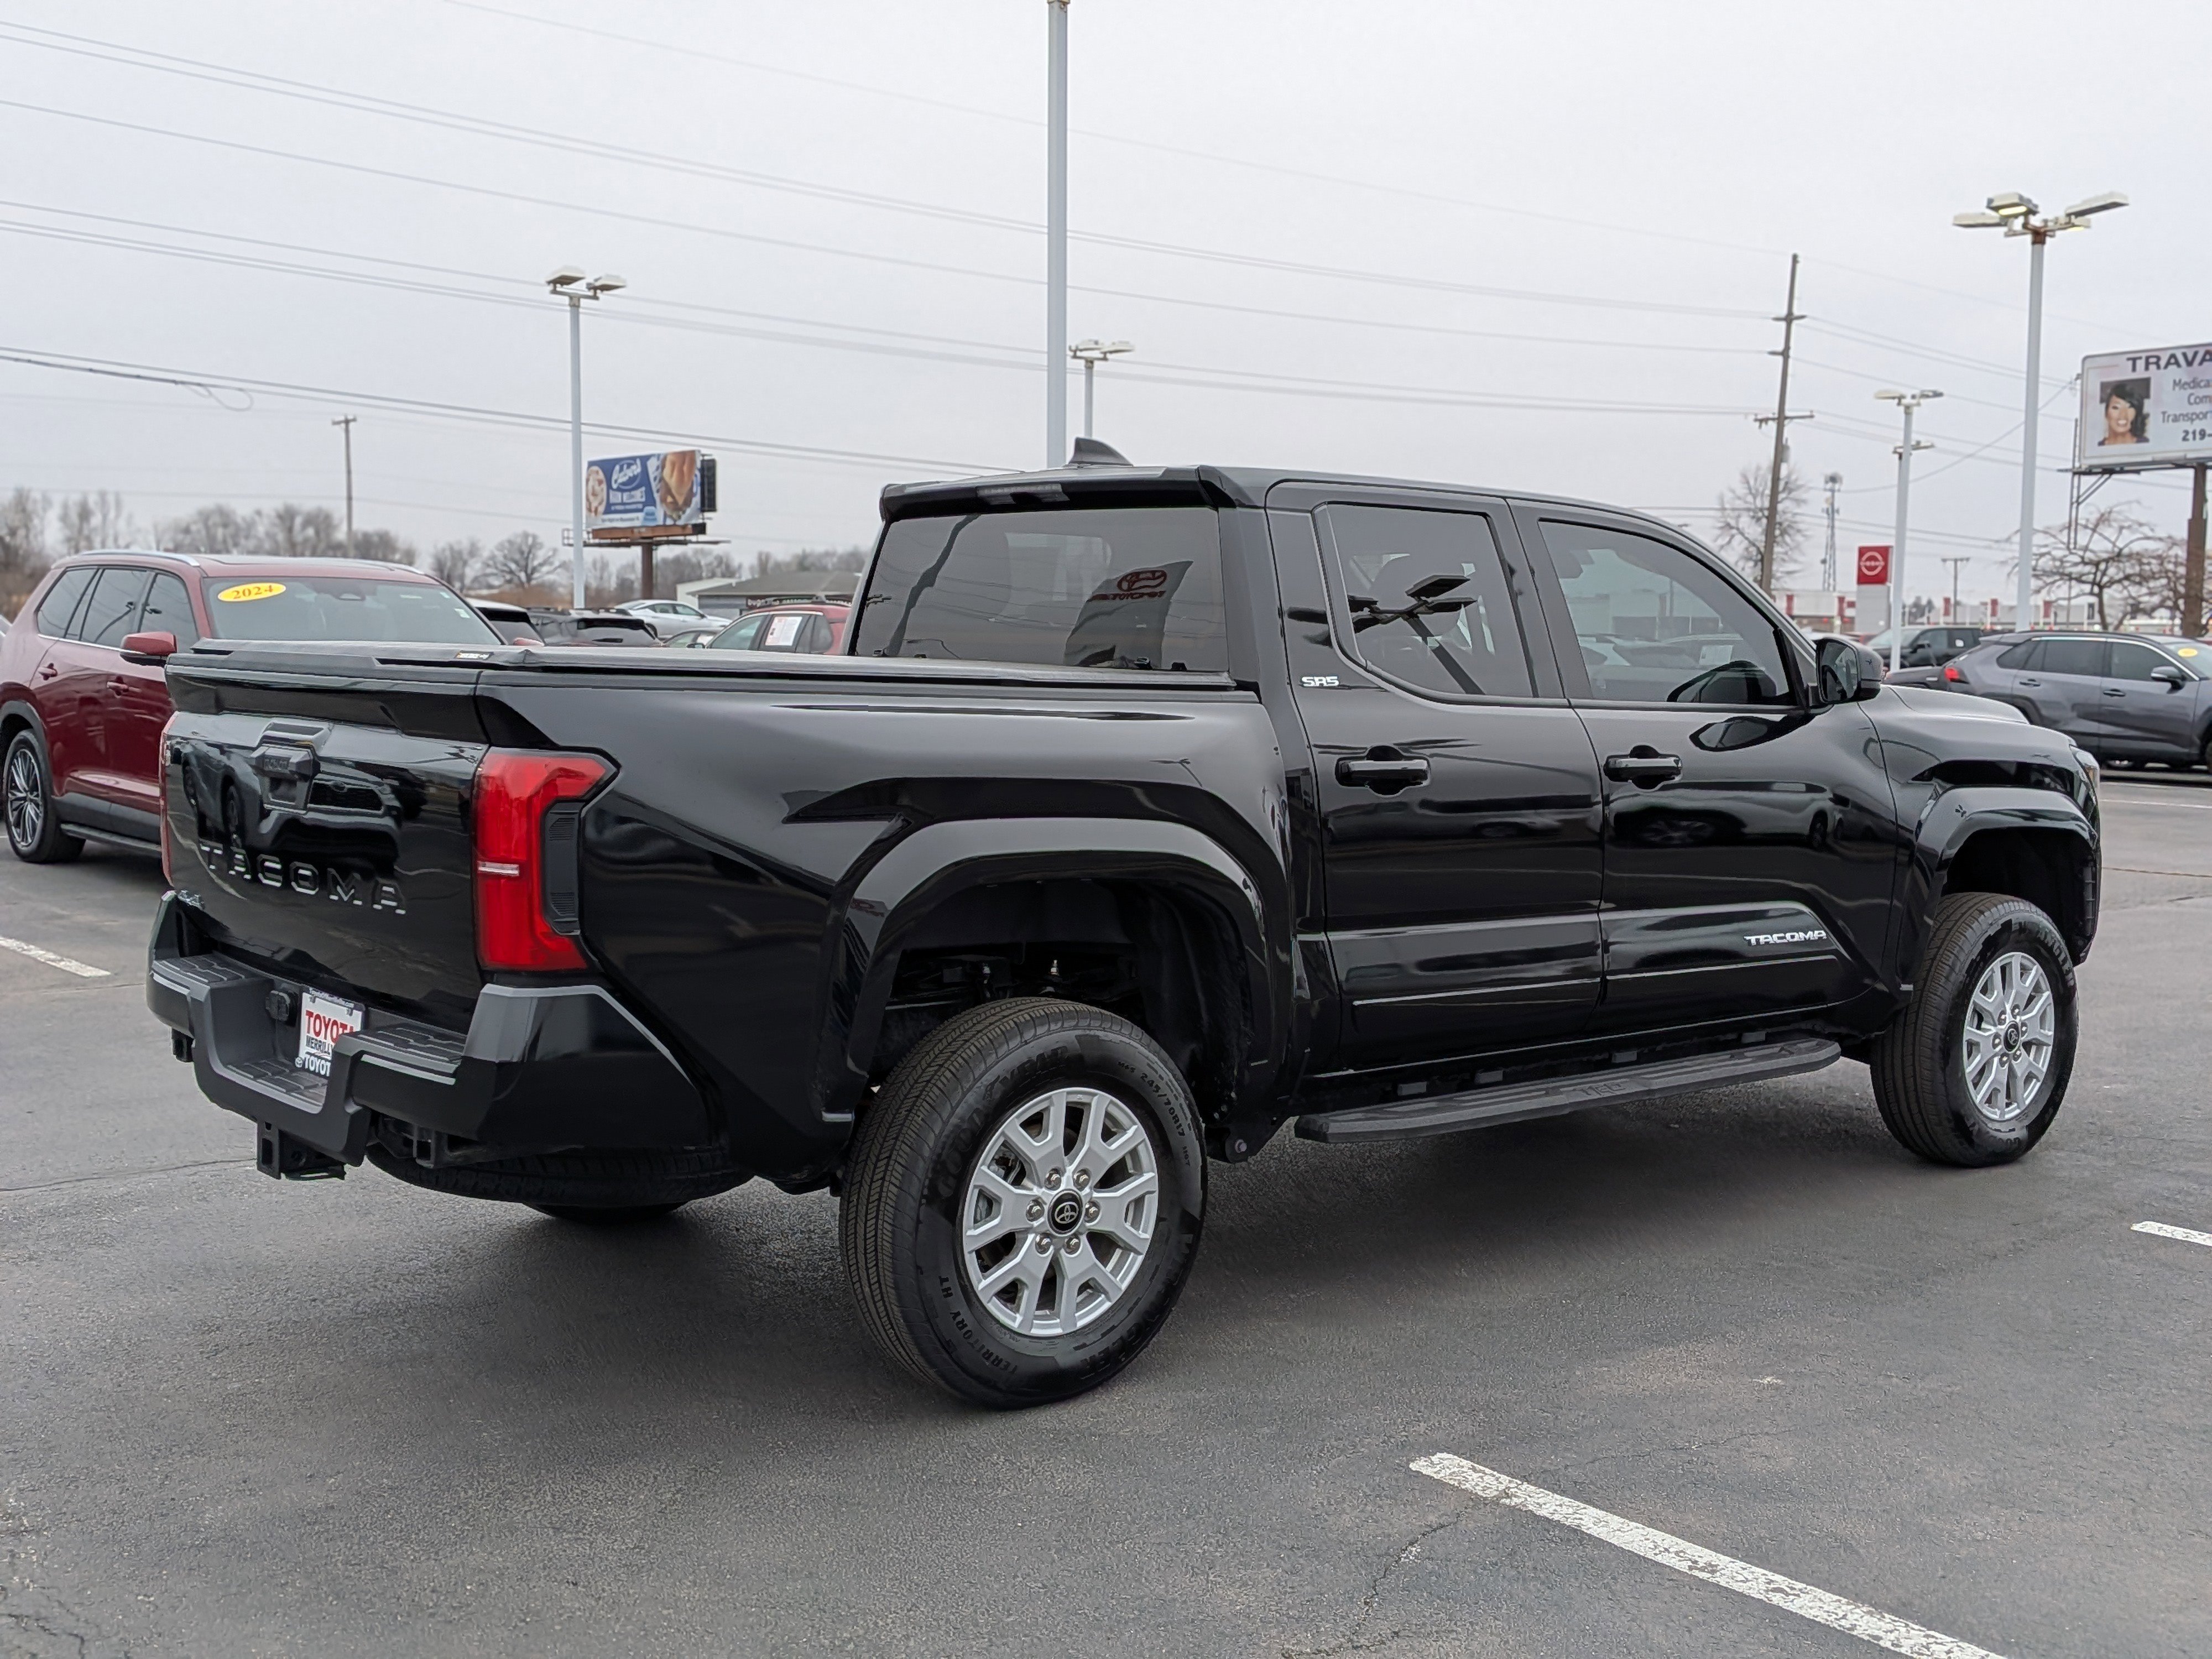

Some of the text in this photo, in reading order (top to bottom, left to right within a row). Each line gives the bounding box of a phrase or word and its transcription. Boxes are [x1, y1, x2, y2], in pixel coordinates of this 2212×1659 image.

[232, 585, 274, 599] 2024
[1301, 676, 1339, 687] SR5
[199, 840, 408, 915] TACOMA
[1743, 930, 1828, 947] TACOMA
[1140, 1073, 1186, 1137] 245/70R17
[938, 1275, 954, 1299] HT
[950, 1310, 1018, 1374] TERRITORY
